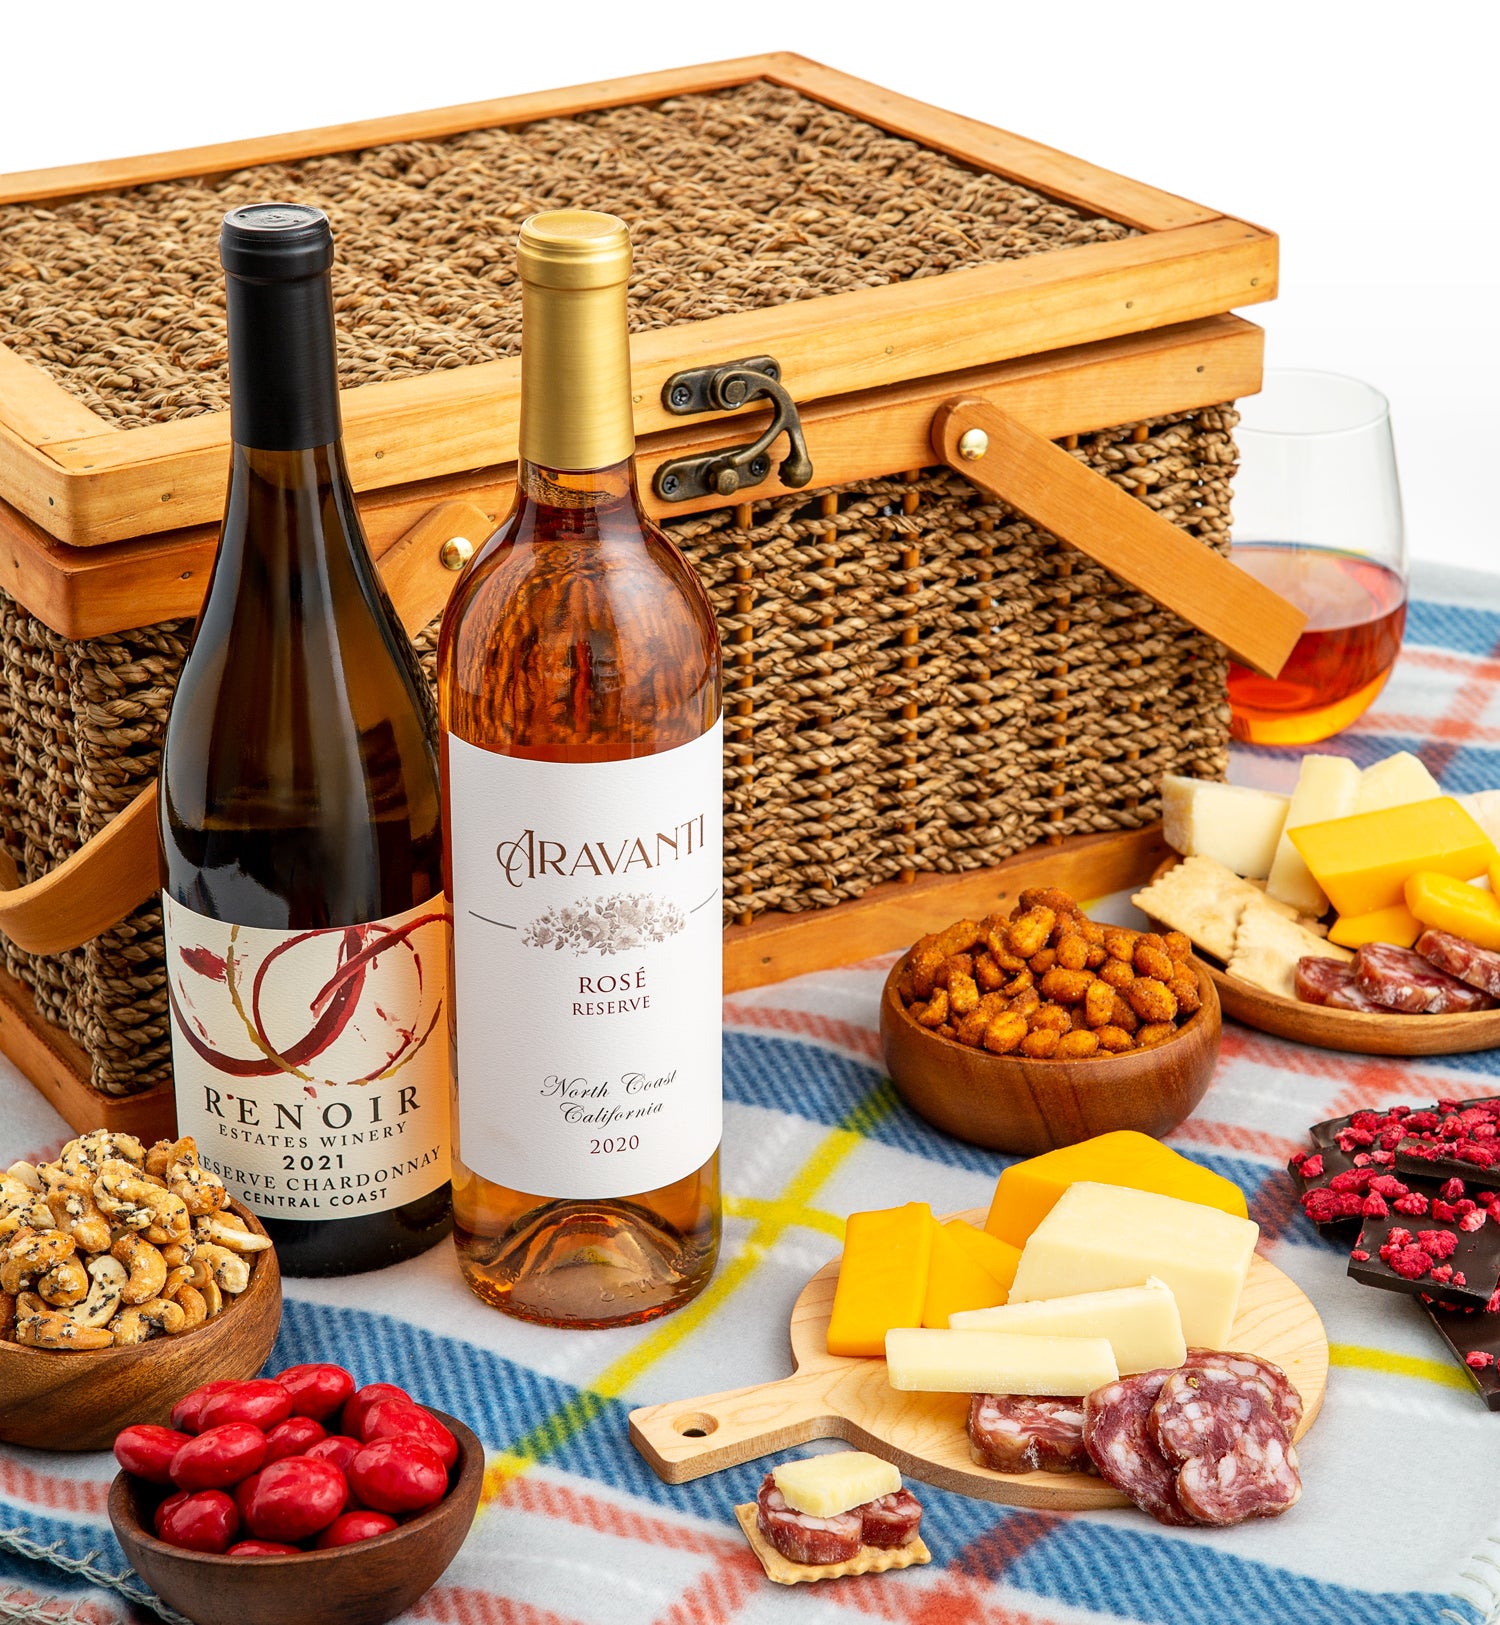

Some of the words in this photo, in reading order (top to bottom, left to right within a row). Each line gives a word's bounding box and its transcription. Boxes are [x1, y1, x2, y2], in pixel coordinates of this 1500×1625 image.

[496, 813, 704, 888] ARAVANTI
[578, 966, 647, 994] ROSÉ
[572, 995, 651, 1016] RESERVE
[540, 1074, 610, 1099] North
[620, 1069, 677, 1095] Coast
[203, 1085, 421, 1130] RENOIR
[559, 1101, 664, 1129] California
[218, 1123, 308, 1149] ESTATES
[320, 1121, 406, 1147] WINERY
[589, 1135, 640, 1154] 2020
[282, 1154, 344, 1170] 2021
[286, 1145, 441, 1191] CHARDONNAY
[243, 1190, 320, 1208] CENTRAL
[329, 1187, 388, 1207] COAST
